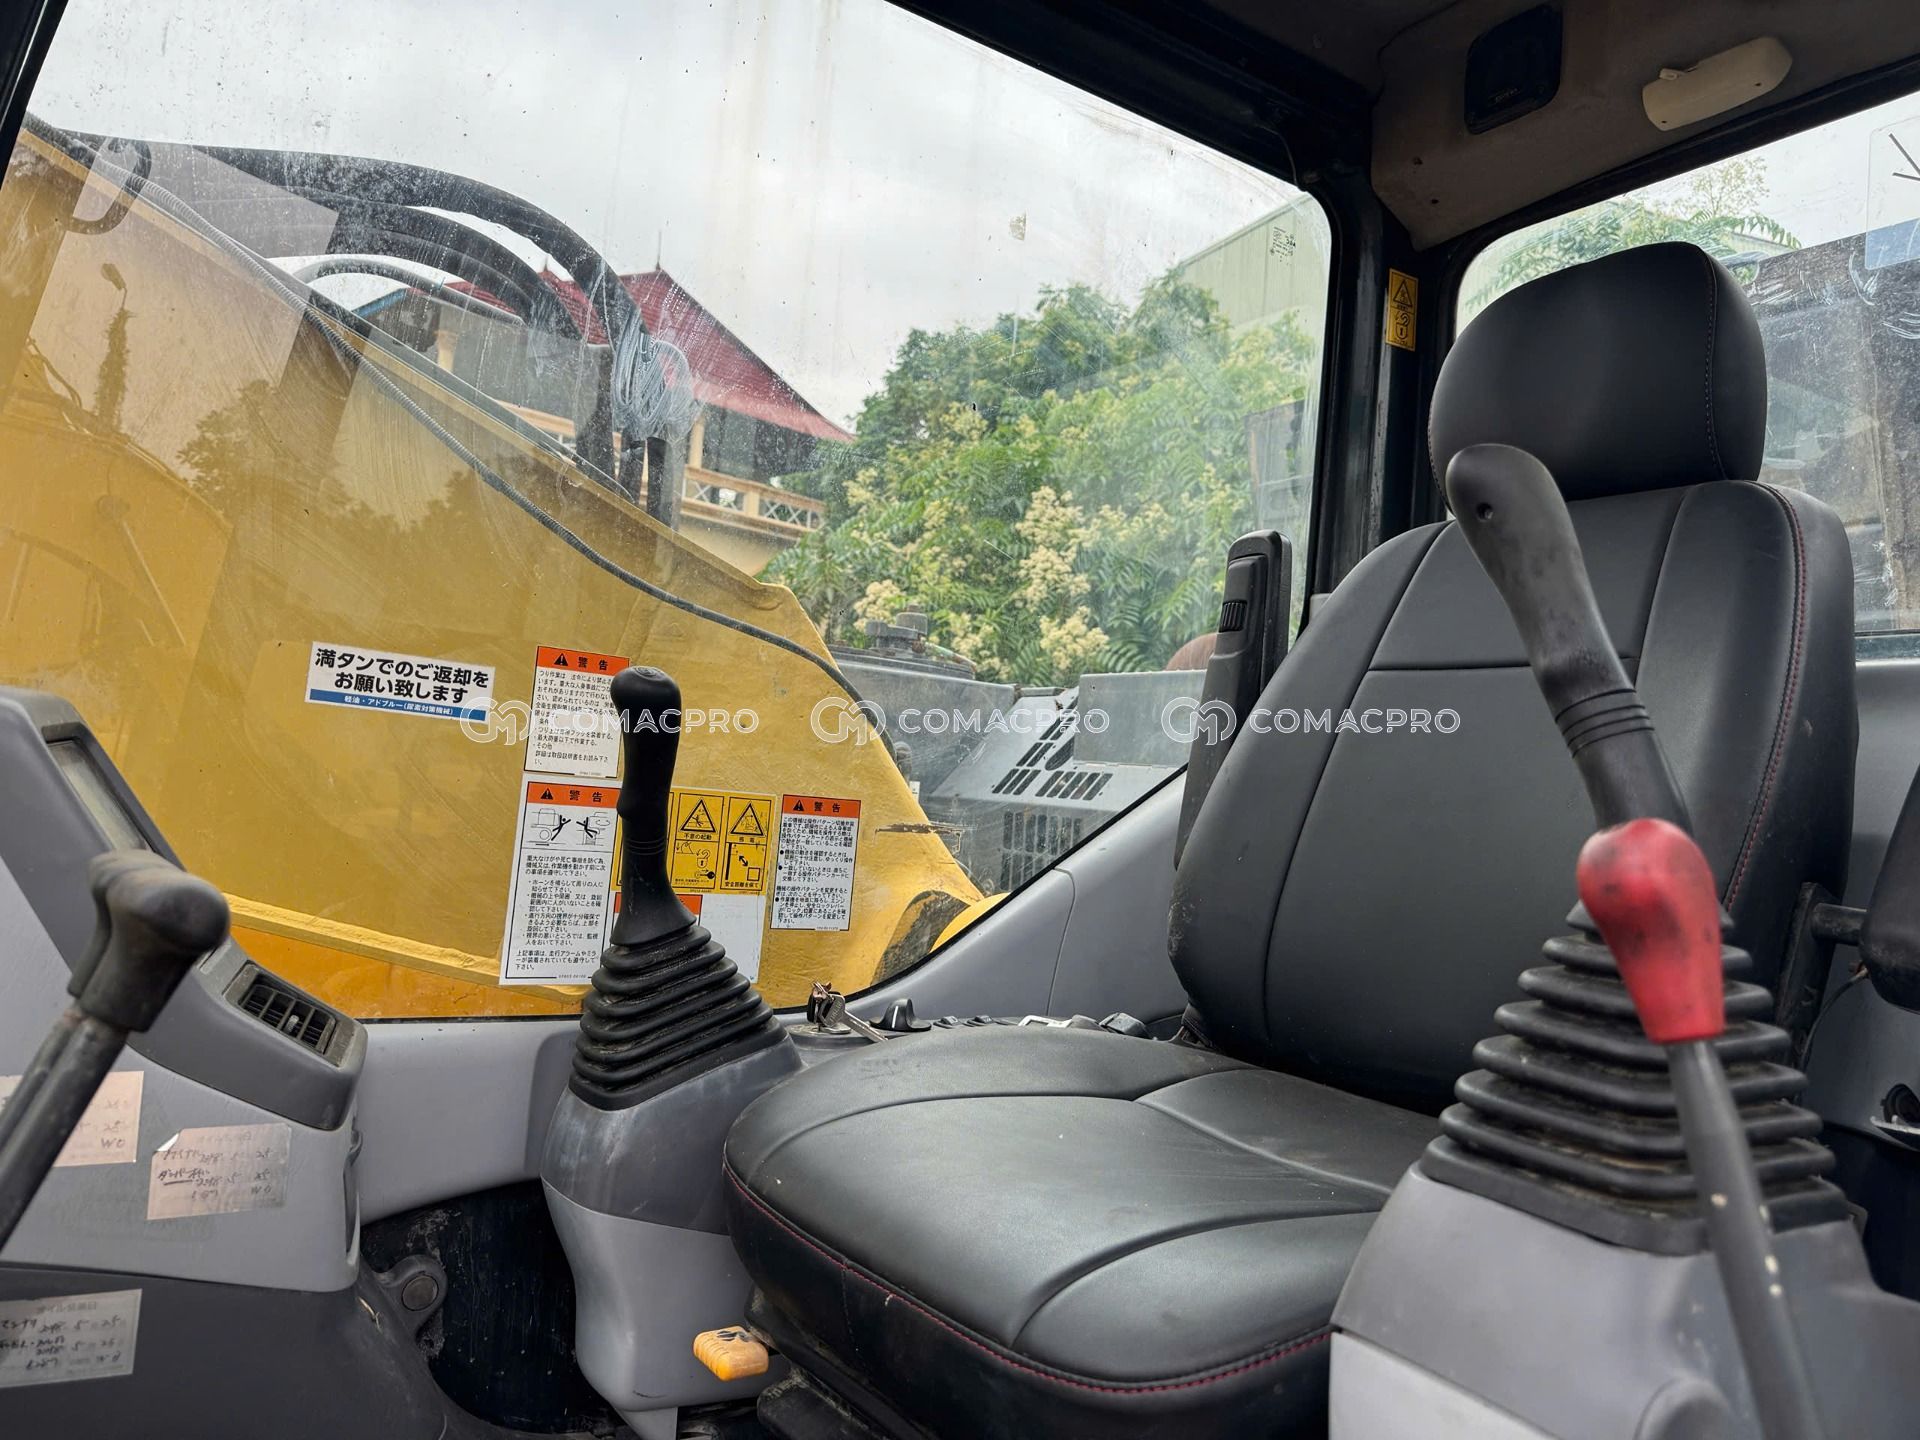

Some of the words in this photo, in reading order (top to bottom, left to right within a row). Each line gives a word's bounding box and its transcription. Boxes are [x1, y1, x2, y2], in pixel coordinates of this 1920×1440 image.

[315, 647, 489, 689] 満タンでのご返却を
[577, 656, 609, 671] 警告
[334, 671, 468, 704] お願い致します
[568, 789, 603, 803] 警告
[813, 801, 841, 814] 警告
